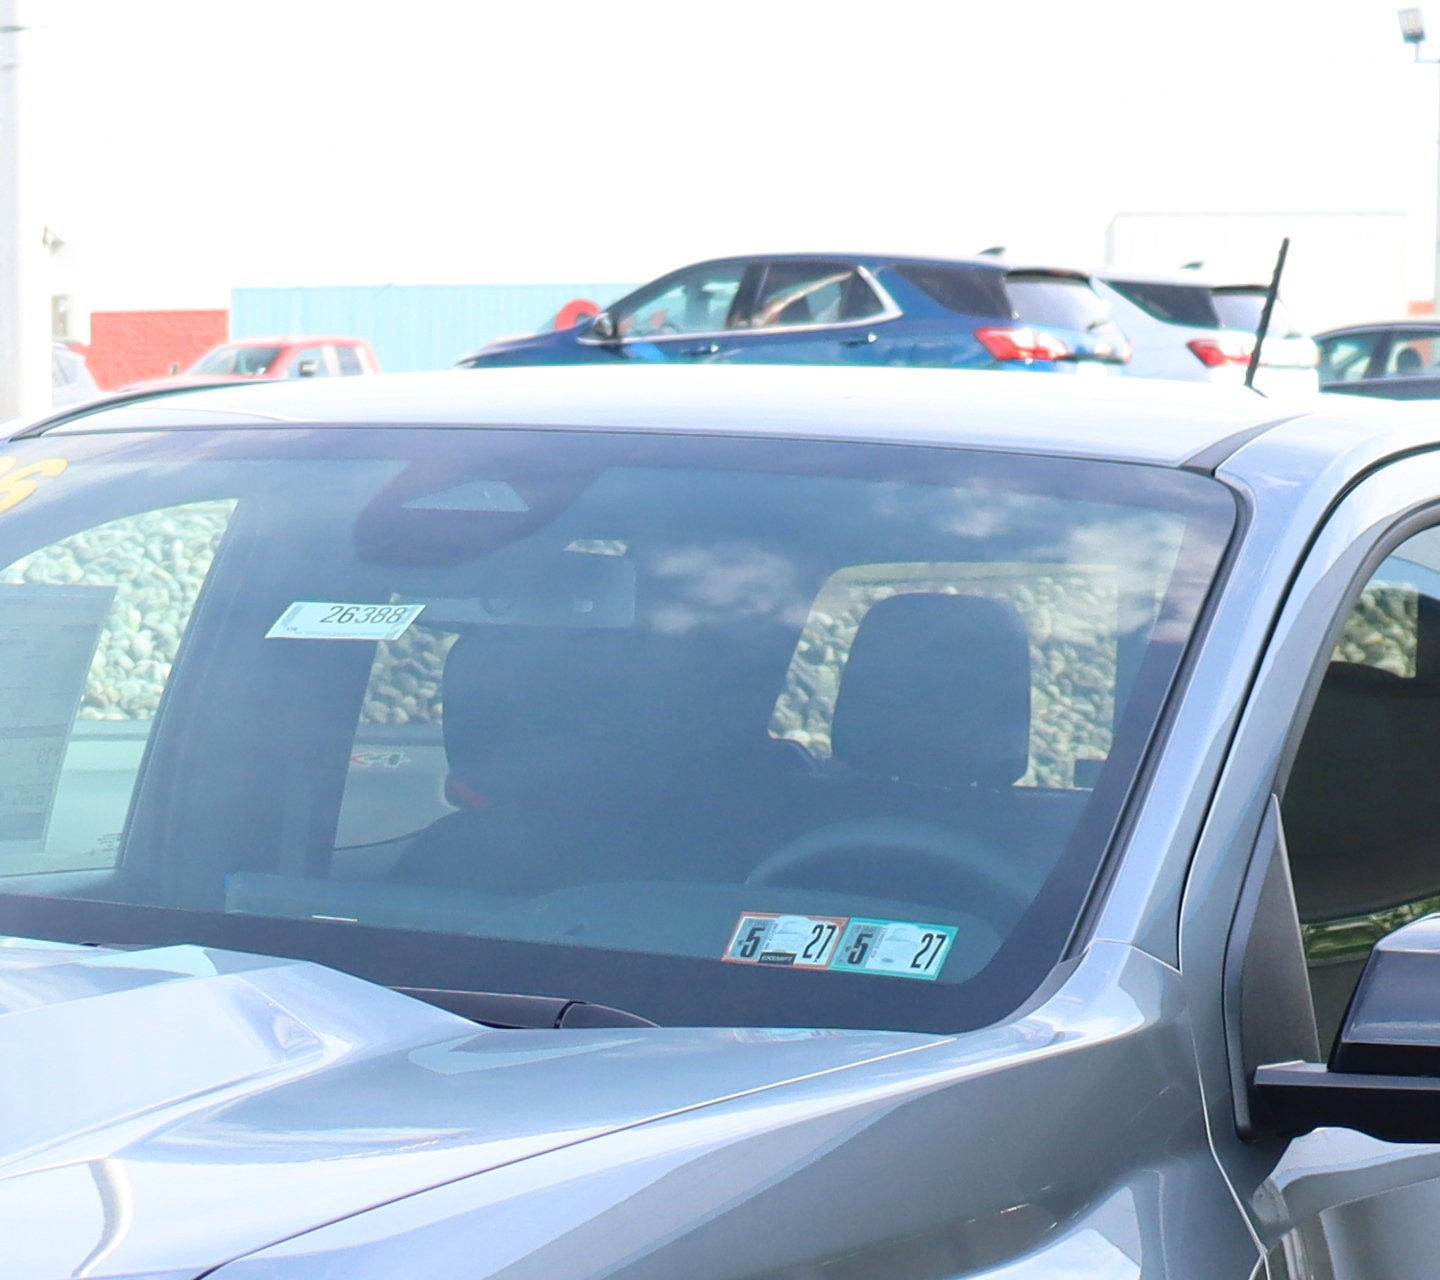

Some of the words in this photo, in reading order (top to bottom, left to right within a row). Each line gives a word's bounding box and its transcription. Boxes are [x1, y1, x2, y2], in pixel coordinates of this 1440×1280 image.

[320, 605, 407, 625] 26388
[740, 927, 766, 958] 5
[802, 924, 837, 960] 27
[847, 933, 874, 965] 5
[909, 932, 947, 971] 27
